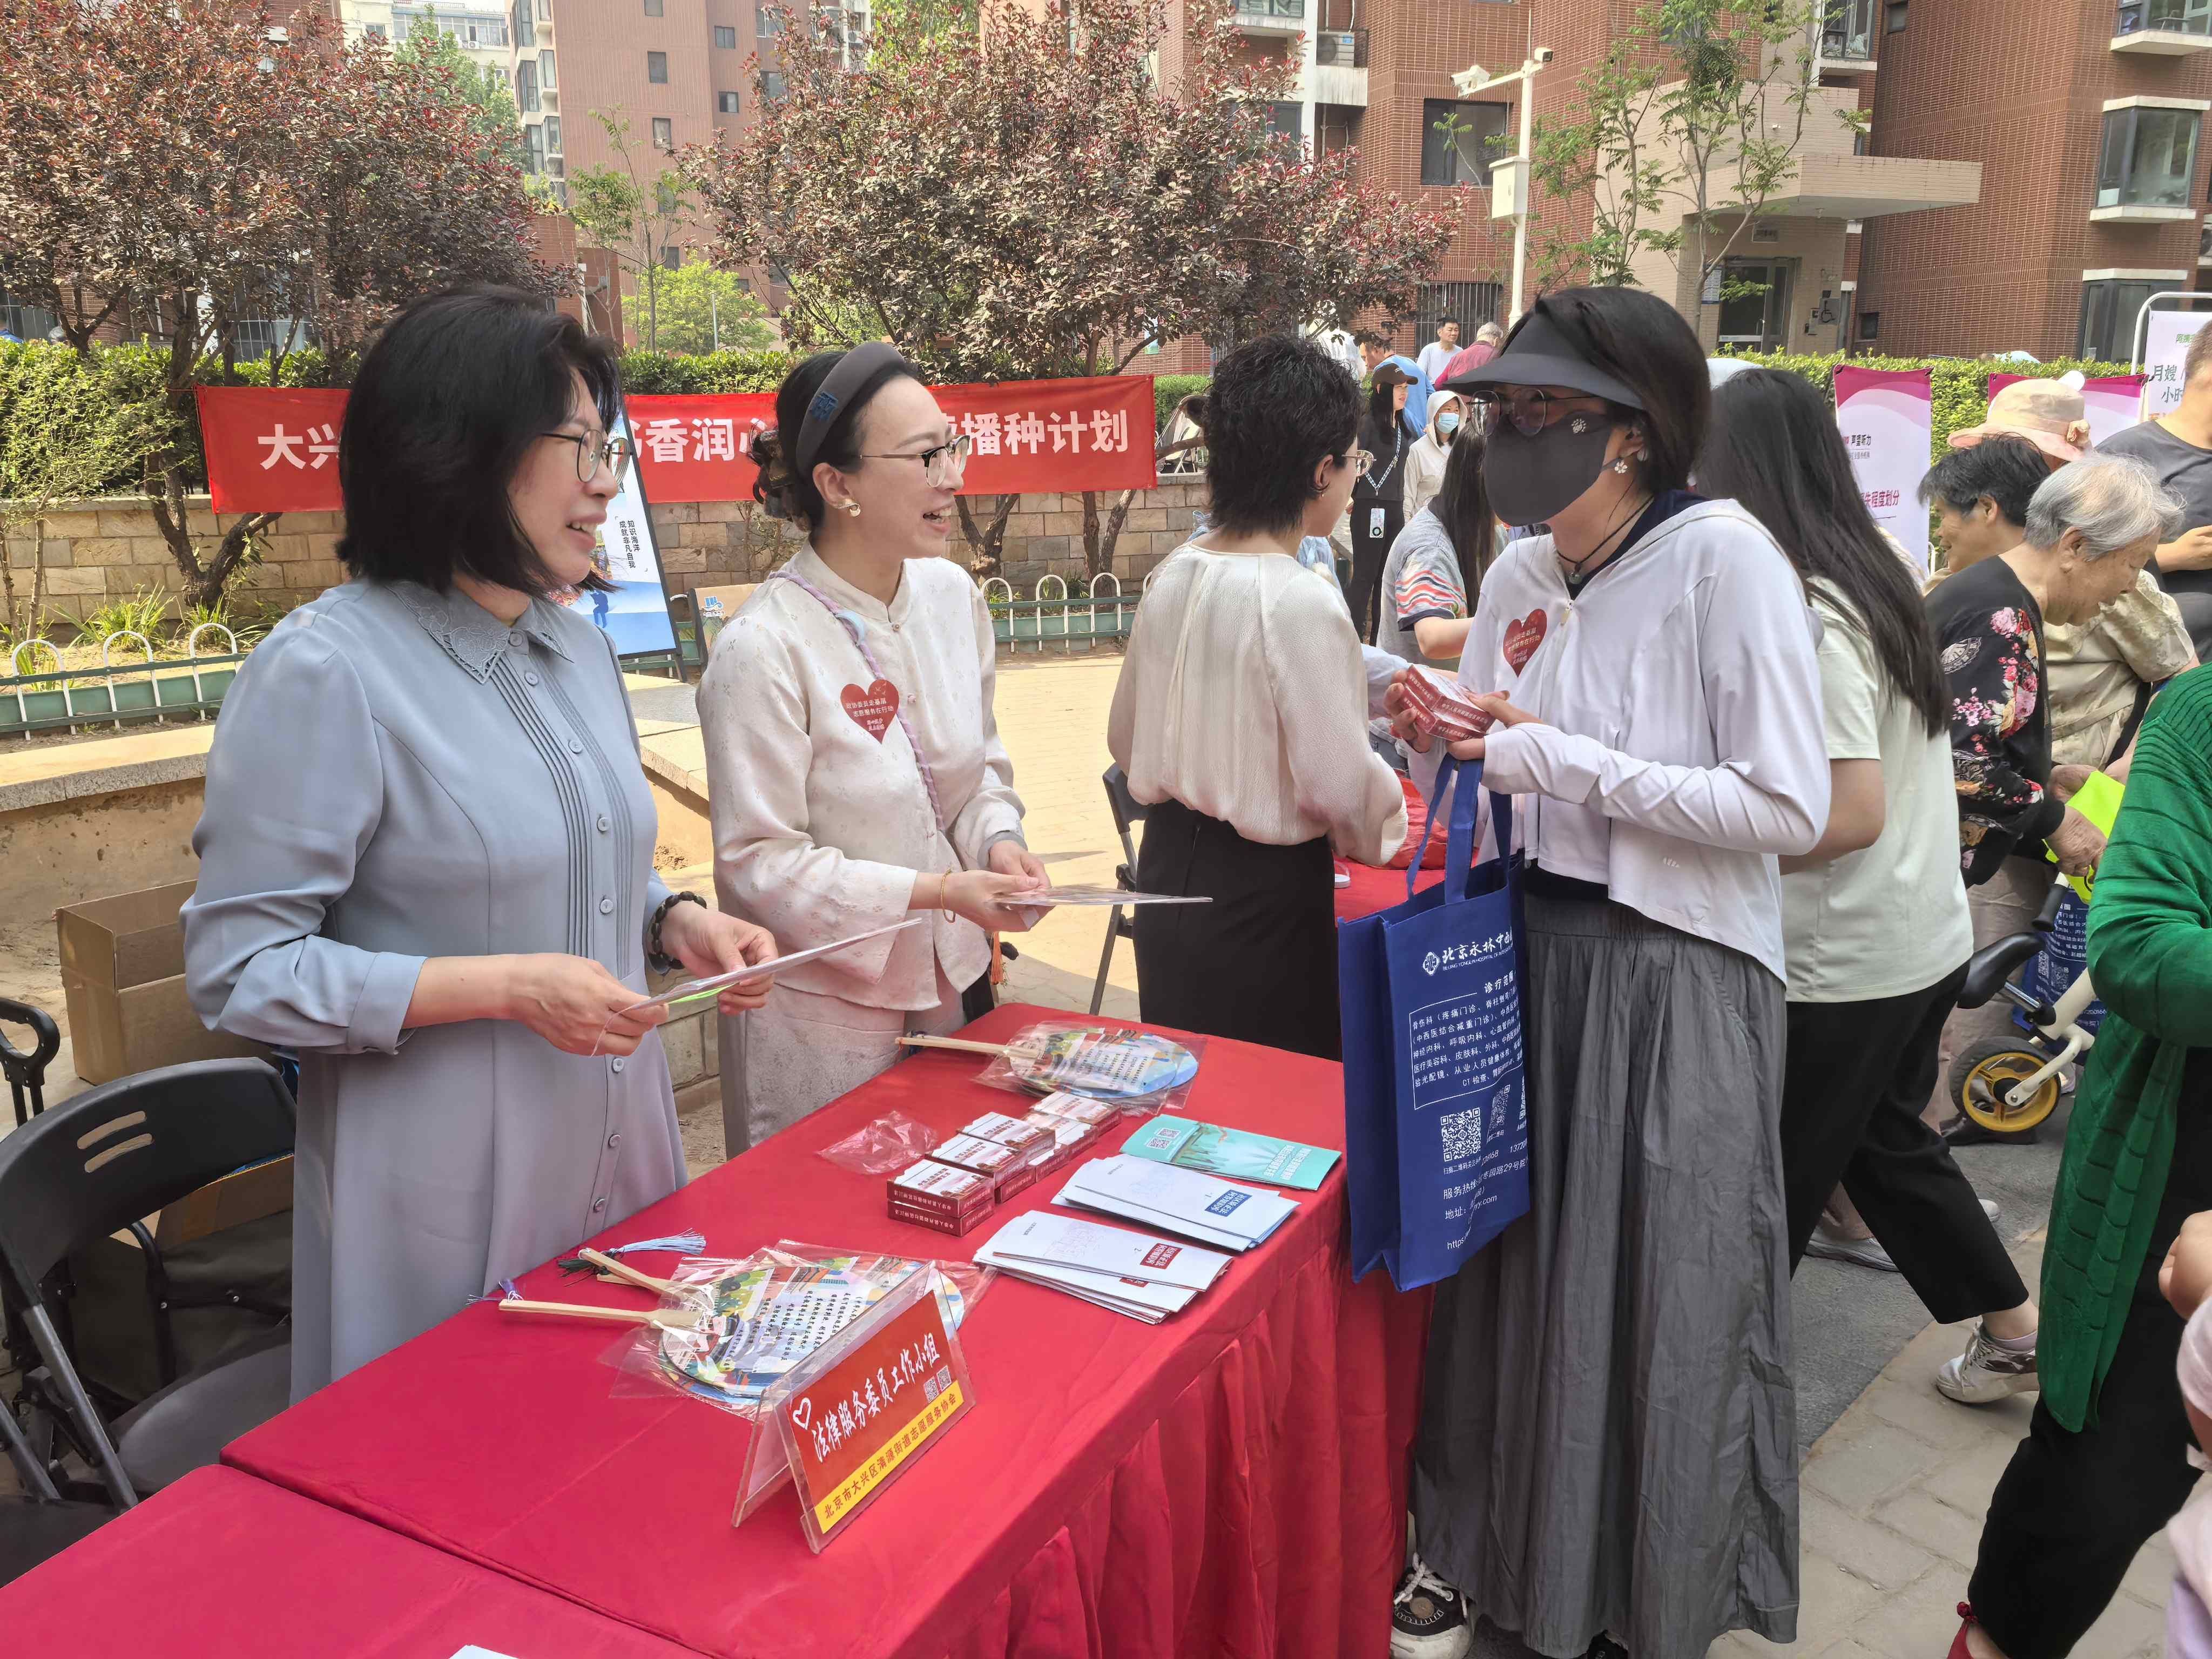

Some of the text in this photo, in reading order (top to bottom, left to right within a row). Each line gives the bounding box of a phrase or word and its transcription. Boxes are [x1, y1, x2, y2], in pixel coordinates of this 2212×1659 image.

[2152, 364, 2177, 382] 月嫂
[258, 423, 339, 470] 大兴
[619, 521, 636, 568] 成就非凡自我
[627, 520, 640, 552] 知识海洋
[812, 1332, 940, 1463] 法律服务委员工作小组
[825, 1393, 957, 1519] 北京市大兴区清源街道志愿服务协会
